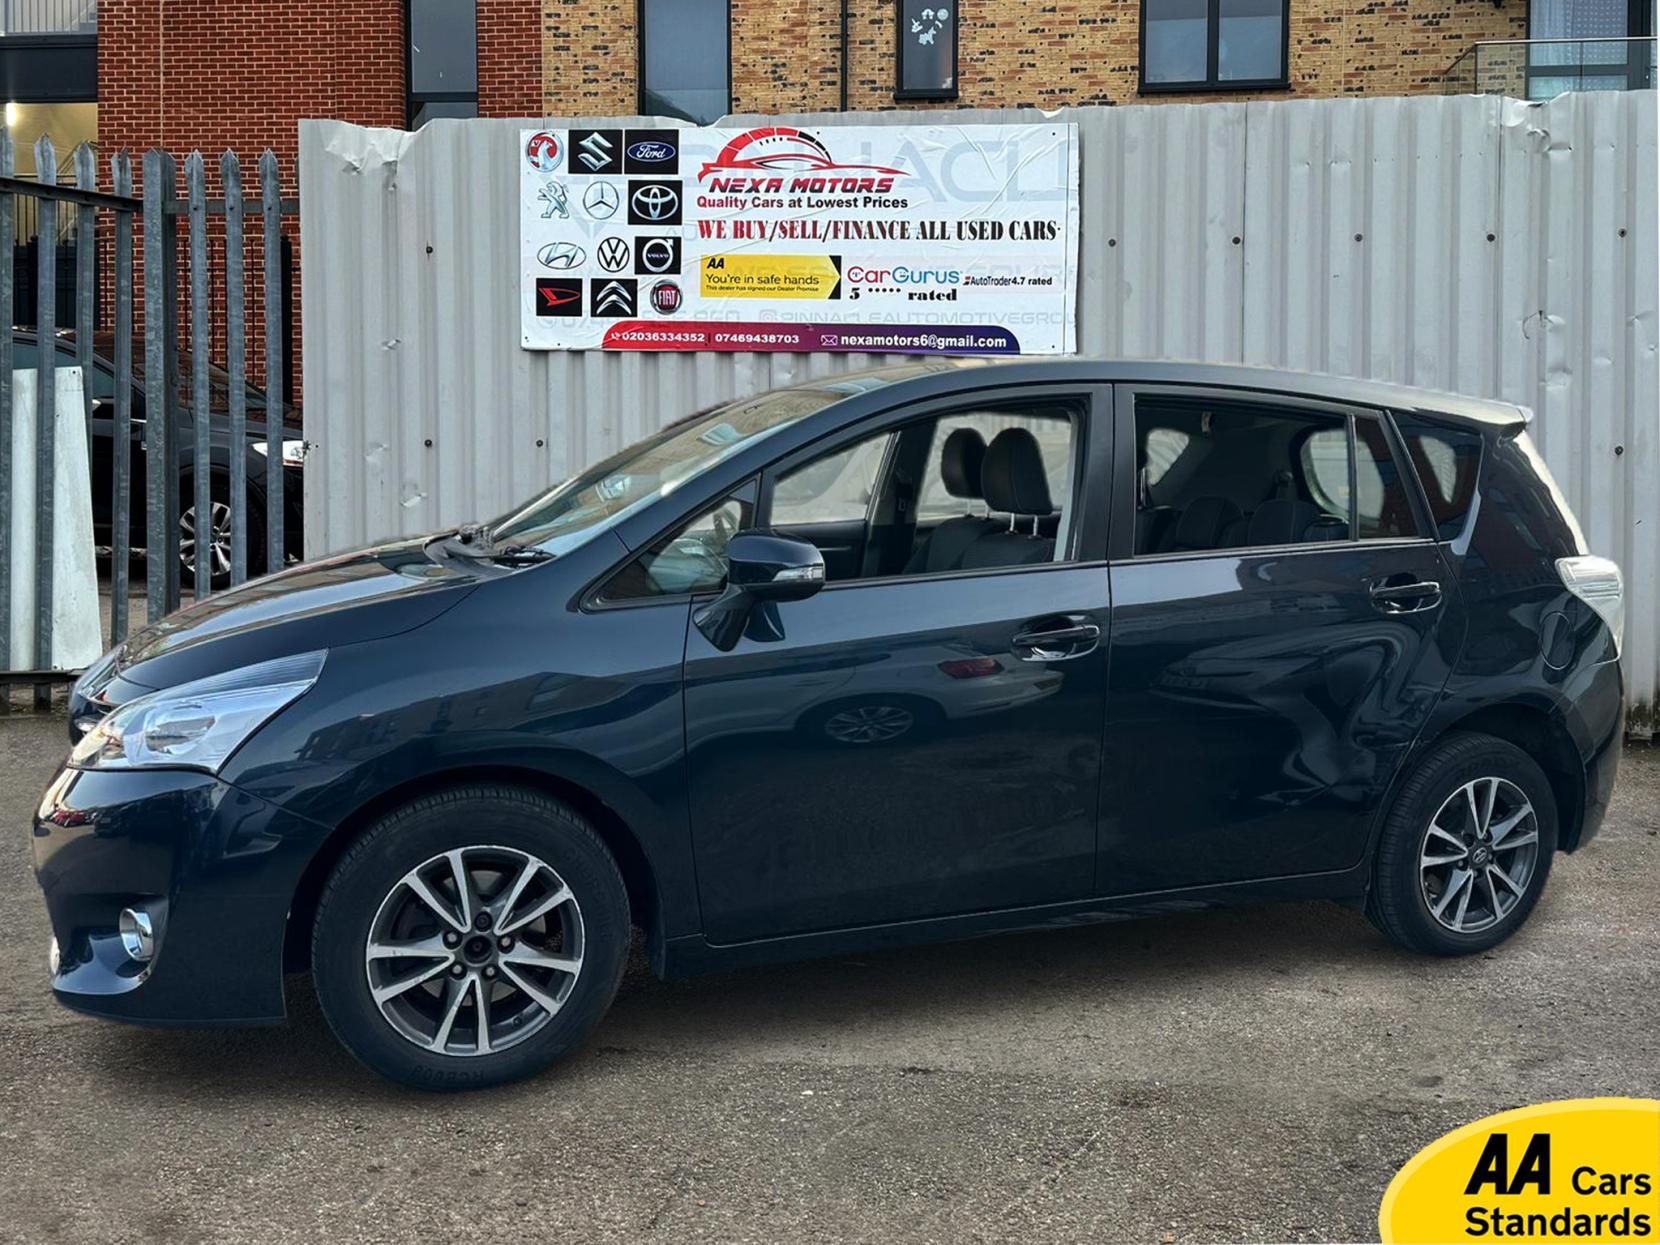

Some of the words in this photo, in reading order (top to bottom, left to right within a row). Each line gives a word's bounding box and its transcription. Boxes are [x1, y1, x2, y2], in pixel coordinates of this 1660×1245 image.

[636, 144, 667, 159] Ford
[709, 178, 783, 193] NEXA
[789, 178, 895, 193] MOTORS
[697, 196, 748, 210] Quality
[752, 196, 784, 208] Cars
[788, 197, 803, 208] at
[807, 196, 859, 208] Lowest
[863, 196, 908, 208] Prices
[697, 220, 727, 240] WE
[733, 220, 911, 243] BUY/SELL/FINANCE
[916, 221, 950, 241] ALL
[956, 221, 1003, 240] USED
[1009, 220, 1057, 240] CARS
[706, 257, 725, 269] AA
[705, 273, 741, 284] You're
[744, 273, 755, 284] in
[757, 274, 781, 284] safe
[784, 274, 820, 285] hands
[847, 265, 960, 285] CarGurus
[1028, 276, 1052, 285] rated
[658, 290, 676, 305] FIAT
[849, 287, 860, 300] 5
[908, 288, 957, 301] rated
[622, 333, 705, 342] 02036334352
[715, 333, 800, 344] 07469438703
[841, 335, 1007, 349] nexamotors6@gmail.com
